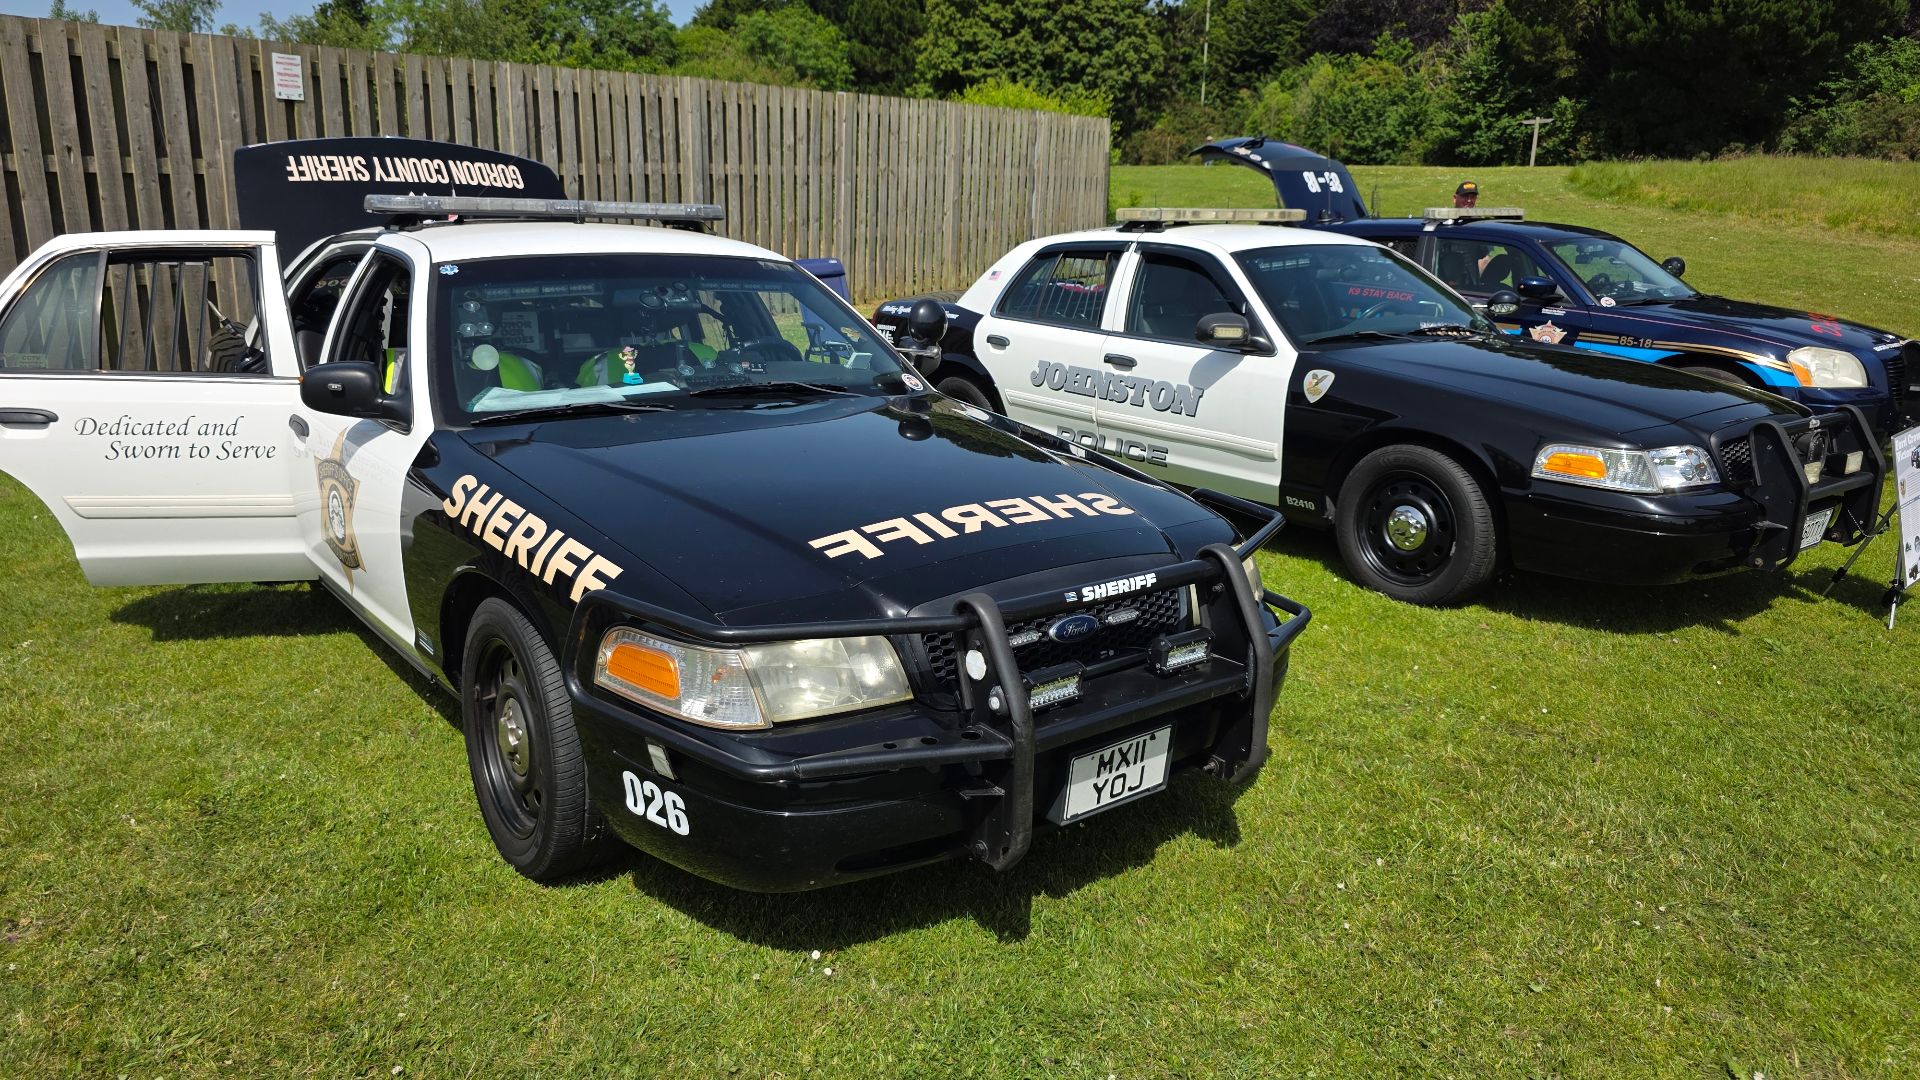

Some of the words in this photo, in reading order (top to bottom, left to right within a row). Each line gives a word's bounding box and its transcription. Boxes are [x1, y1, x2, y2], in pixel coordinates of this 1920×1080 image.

[286, 155, 370, 182] SHERIFF
[371, 156, 450, 184] COUNTY
[448, 159, 525, 190] GORDON
[1362, 288, 1385, 298] STAY
[1386, 291, 1414, 301] BACK
[1619, 335, 1653, 349] 85-18
[1030, 360, 1205, 418] JOHNSTON
[74, 414, 196, 436] Dedicated
[197, 415, 245, 436] and
[105, 440, 181, 461] Sworn
[189, 442, 210, 459] to
[216, 440, 276, 461] Serve
[1286, 495, 1315, 510] B2410
[442, 474, 625, 603] SHERIFF
[1081, 572, 1157, 602] SHERIFF
[1063, 622, 1089, 637] Ford
[1096, 738, 1147, 778] MX11
[1093, 764, 1145, 804] YOJ
[622, 770, 690, 836] 026
